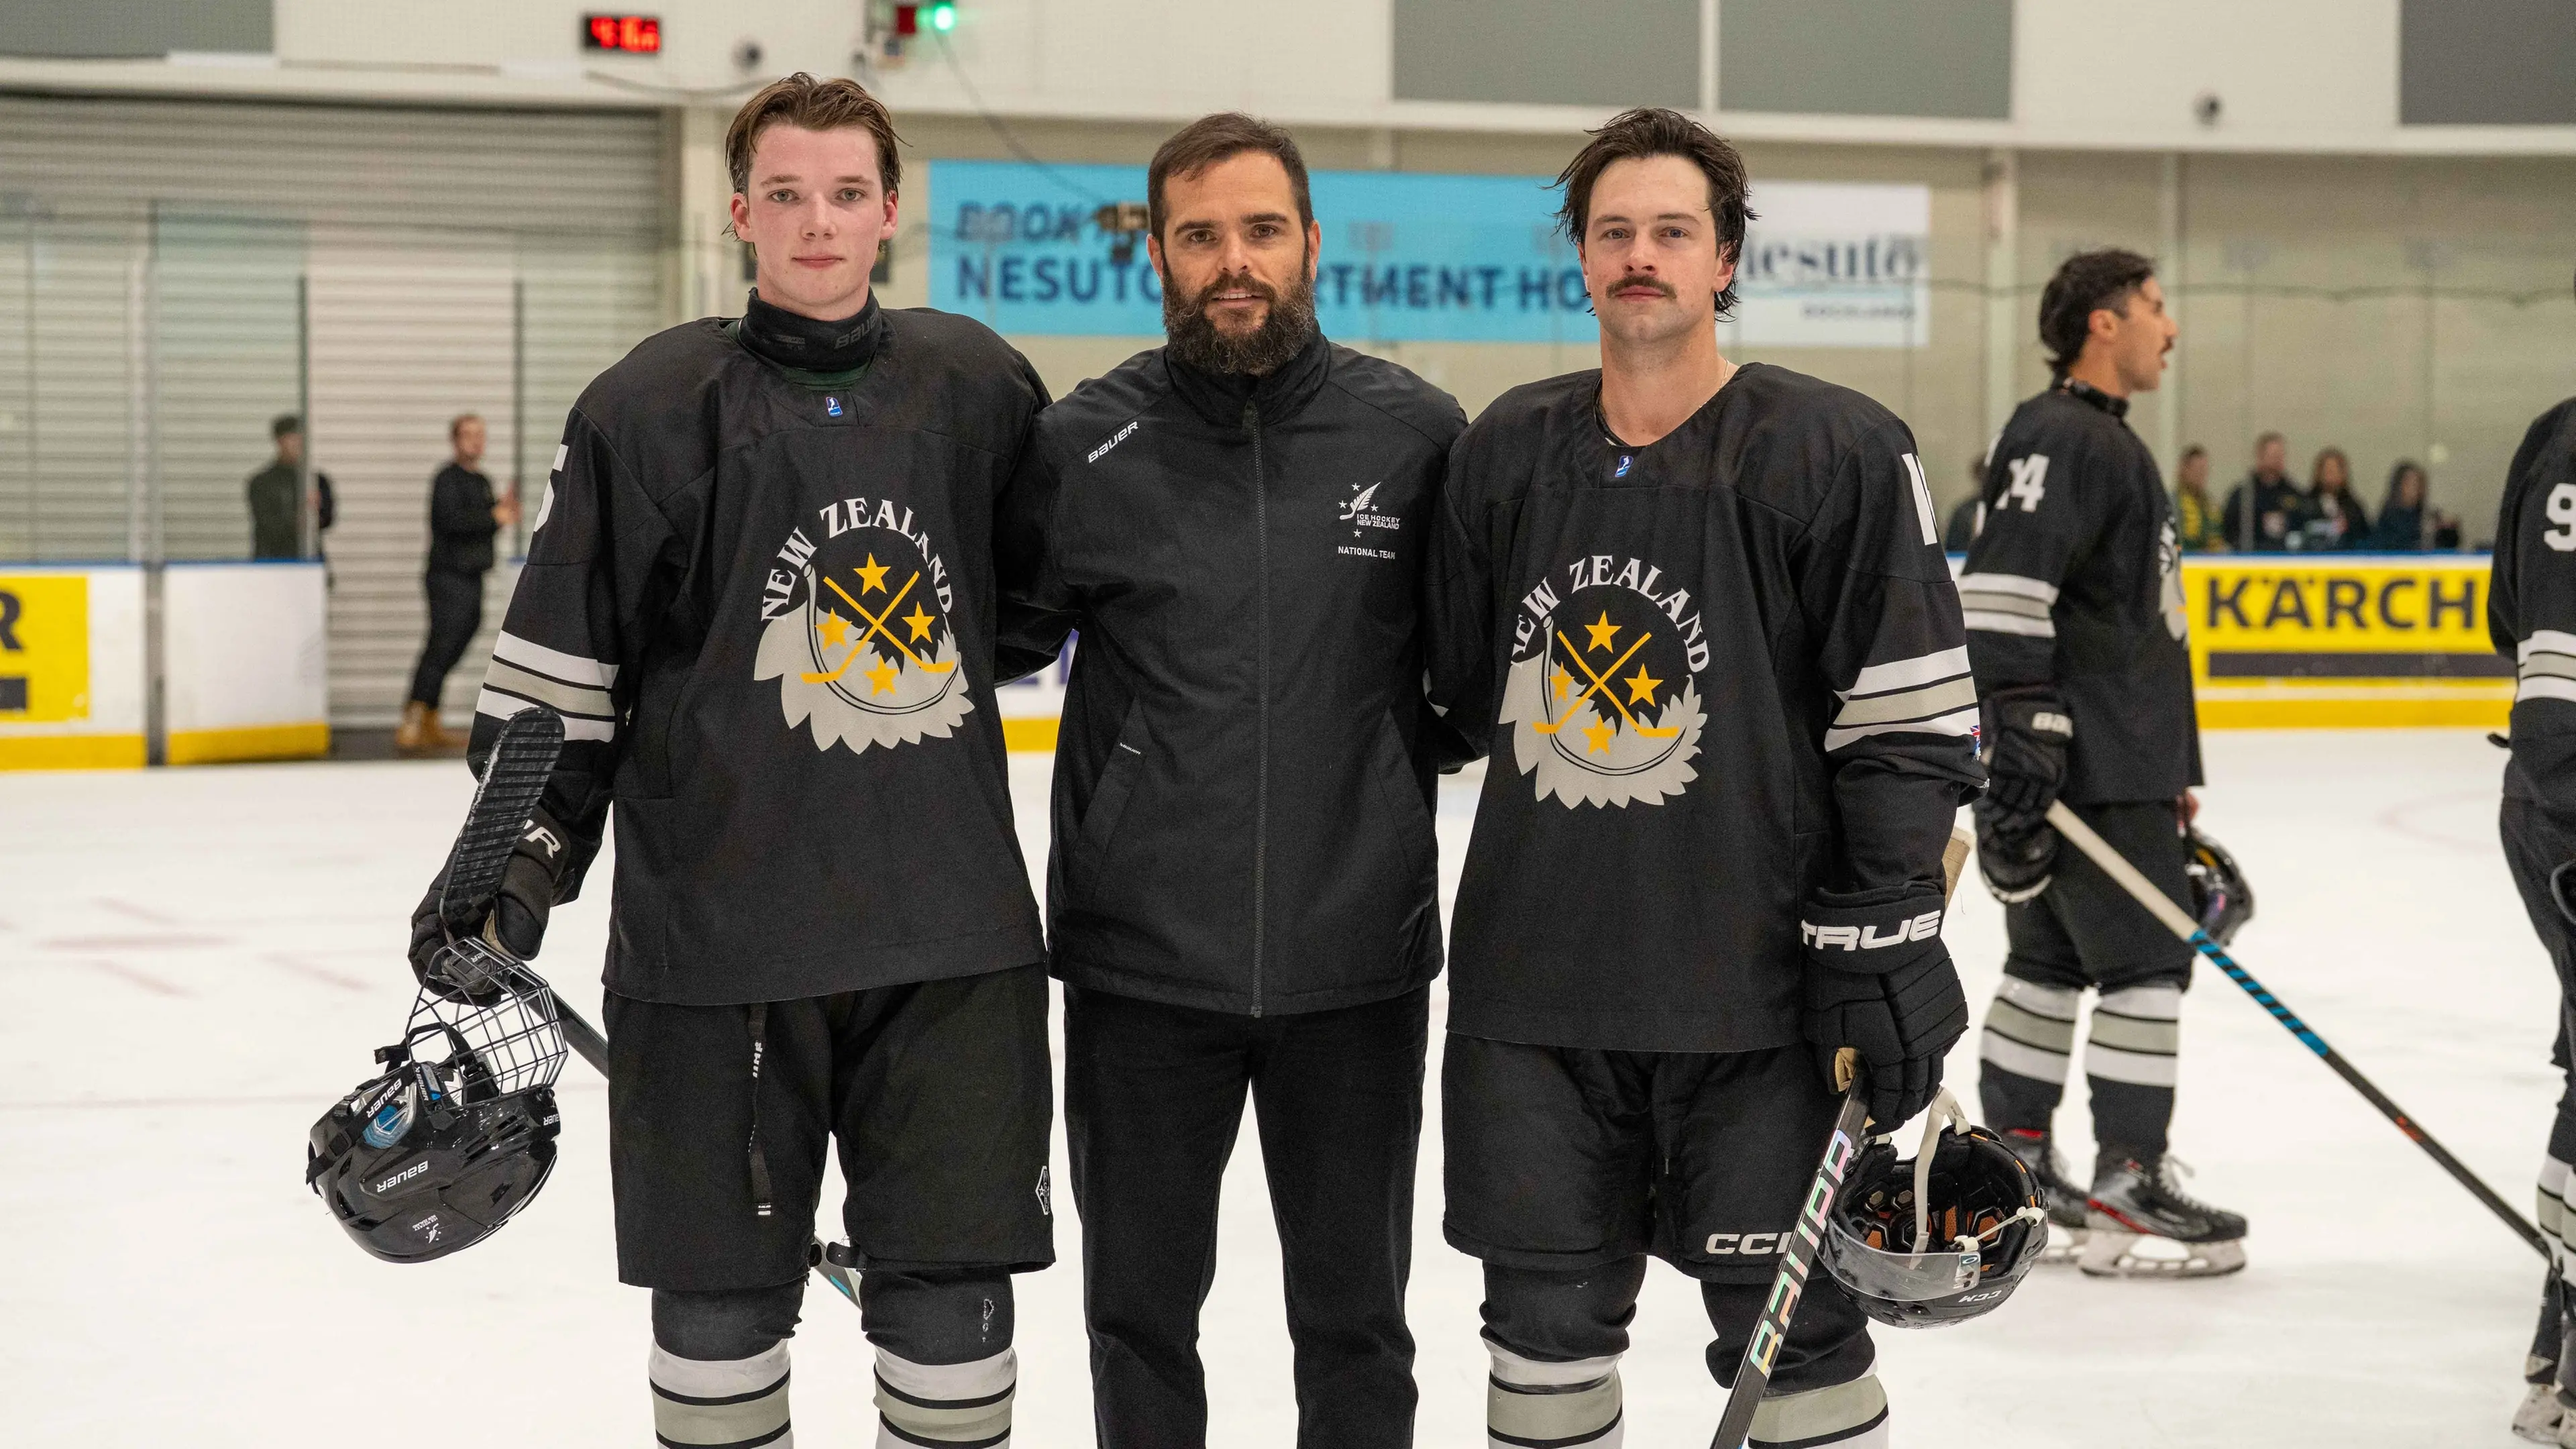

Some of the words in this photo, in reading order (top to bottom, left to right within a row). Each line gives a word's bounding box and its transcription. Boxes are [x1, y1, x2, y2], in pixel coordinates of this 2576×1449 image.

[1087, 421, 1138, 464] BAUER
[1371, 515, 1401, 523] HOCKEY
[1373, 520, 1399, 530] ZEALAND
[761, 526, 818, 622] NEW
[819, 497, 953, 613] ZEALAND
[1338, 545, 1378, 557] NATIONAL
[1379, 550, 1395, 559] TEAM
[1569, 555, 1710, 673] ZEALAND
[1801, 909, 1941, 951] TRUE
[366, 1078, 402, 1118] BAUER
[376, 1160, 429, 1193] BAUER
[1958, 1289, 2002, 1303] CCM
